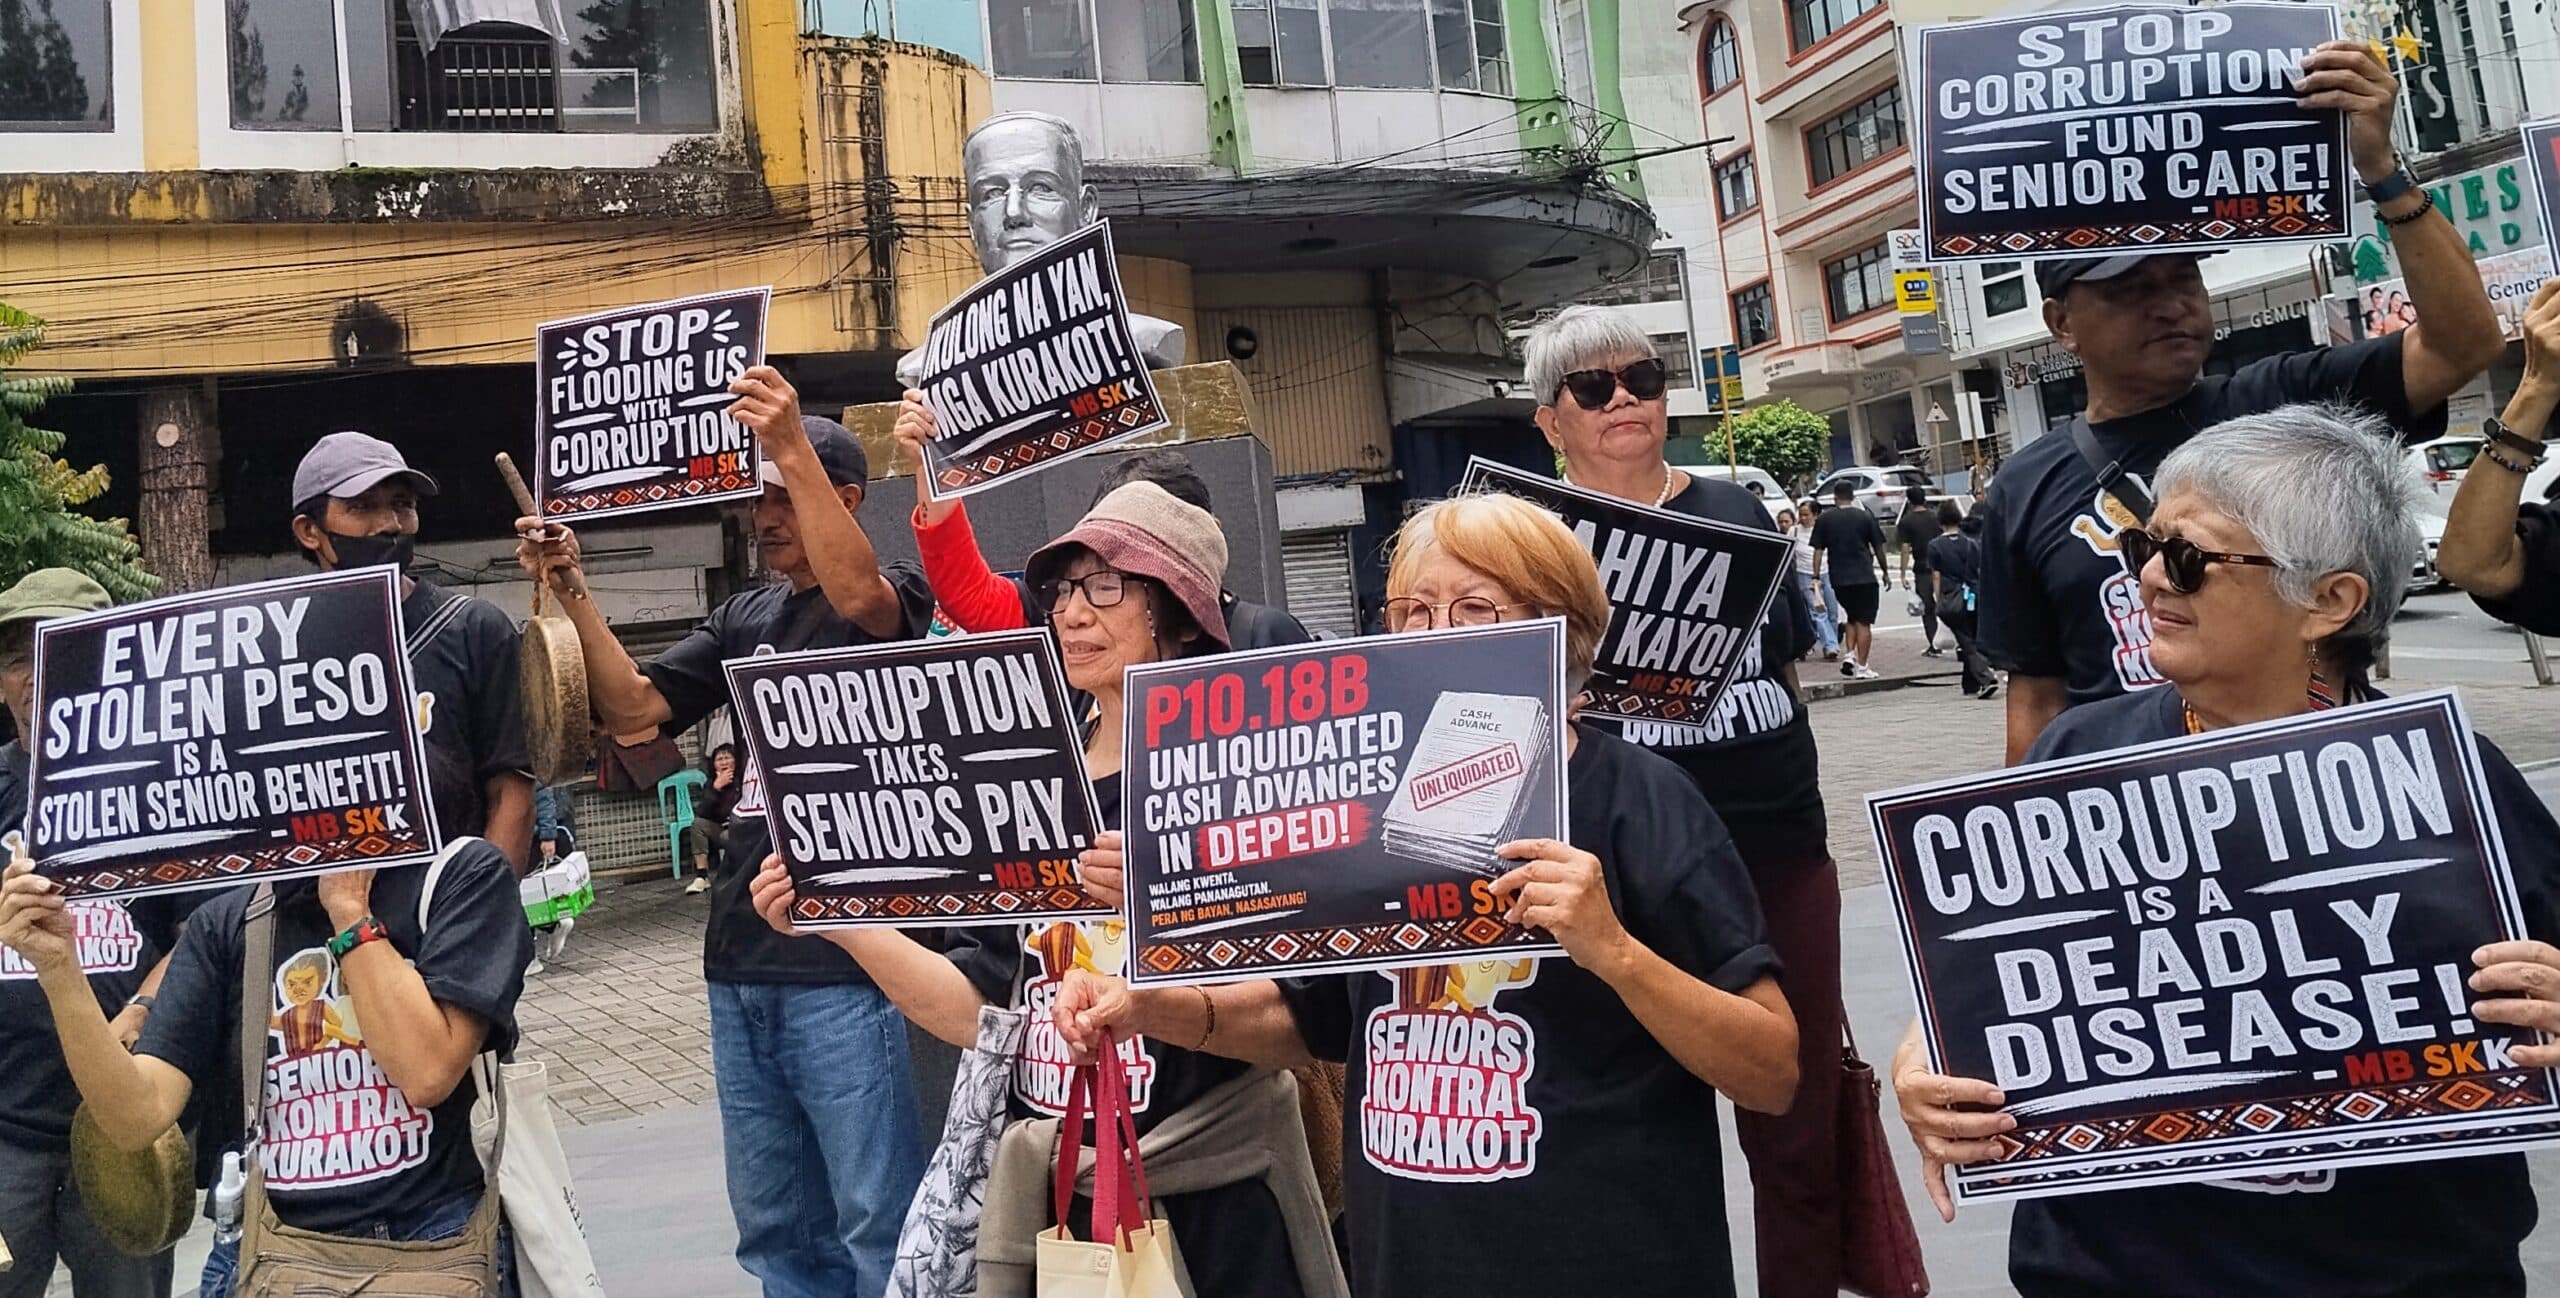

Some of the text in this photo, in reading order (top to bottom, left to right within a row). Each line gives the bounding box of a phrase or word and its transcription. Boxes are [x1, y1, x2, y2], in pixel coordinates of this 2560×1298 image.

[2017, 11, 2233, 68] STOP
[1940, 46, 2314, 120] CORRUPTION
[2065, 111, 2204, 158] FUND
[1943, 143, 2330, 214] SENIOR CARE!
[2266, 194, 2327, 216] SKK
[1013, 272, 1051, 339] NA
[1048, 248, 1112, 322] YAN,
[582, 308, 709, 367] STOP
[551, 345, 748, 415] FLOODING US
[921, 315, 1132, 442] MGA KURAKOT!
[1098, 376, 1143, 409] SKK
[622, 397, 672, 423] WITH
[550, 408, 750, 478] CORRUPTION!
[718, 452, 750, 474] SKK
[101, 597, 312, 687] EVERY
[1612, 610, 1742, 678] KAYO!
[45, 652, 389, 760] STOLEN PESO
[753, 653, 1054, 750] CORRUPTION
[1145, 655, 1370, 749] P10.18B
[1460, 708, 1493, 720] CASH
[1666, 676, 1715, 698] SKK
[1149, 711, 1404, 790] UNLIQUIDATED
[1450, 717, 1503, 733] ADVANCE
[174, 739, 229, 777] IS A
[863, 743, 959, 786] TAKES.
[1416, 751, 1516, 803] UNLIQUIDATED
[37, 750, 408, 847] STOLEN SENIOR BENEFIT!
[345, 803, 411, 836] SKK
[782, 777, 1087, 863] SENIORS PAY.
[1144, 755, 1398, 832] CASH ADVANCES
[1912, 727, 2454, 916] CORRUPTION
[1159, 804, 1350, 875] IN DEPED!
[1149, 871, 1238, 897] WALANG KWENTA.
[1150, 881, 1272, 912] WALANG PANANAGUTAN.
[1151, 911, 1179, 927] PERA
[1180, 909, 1196, 923] NG
[1235, 890, 1308, 915] NASASAYANG!
[1470, 879, 1519, 915] SK
[2123, 877, 2234, 926] IS A
[1994, 891, 2402, 1018] DEADLY
[1371, 1014, 1522, 1073] SENIORS
[1984, 961, 2476, 1091] DISEASE!
[265, 1048, 402, 1103] SENIOR
[2423, 1036, 2520, 1078] SKK
[266, 1086, 412, 1142] KONTRA
[1372, 1062, 1515, 1119] KONTRA
[259, 1118, 424, 1181] KURAKOT
[1367, 1108, 1529, 1169] KURAKOT
